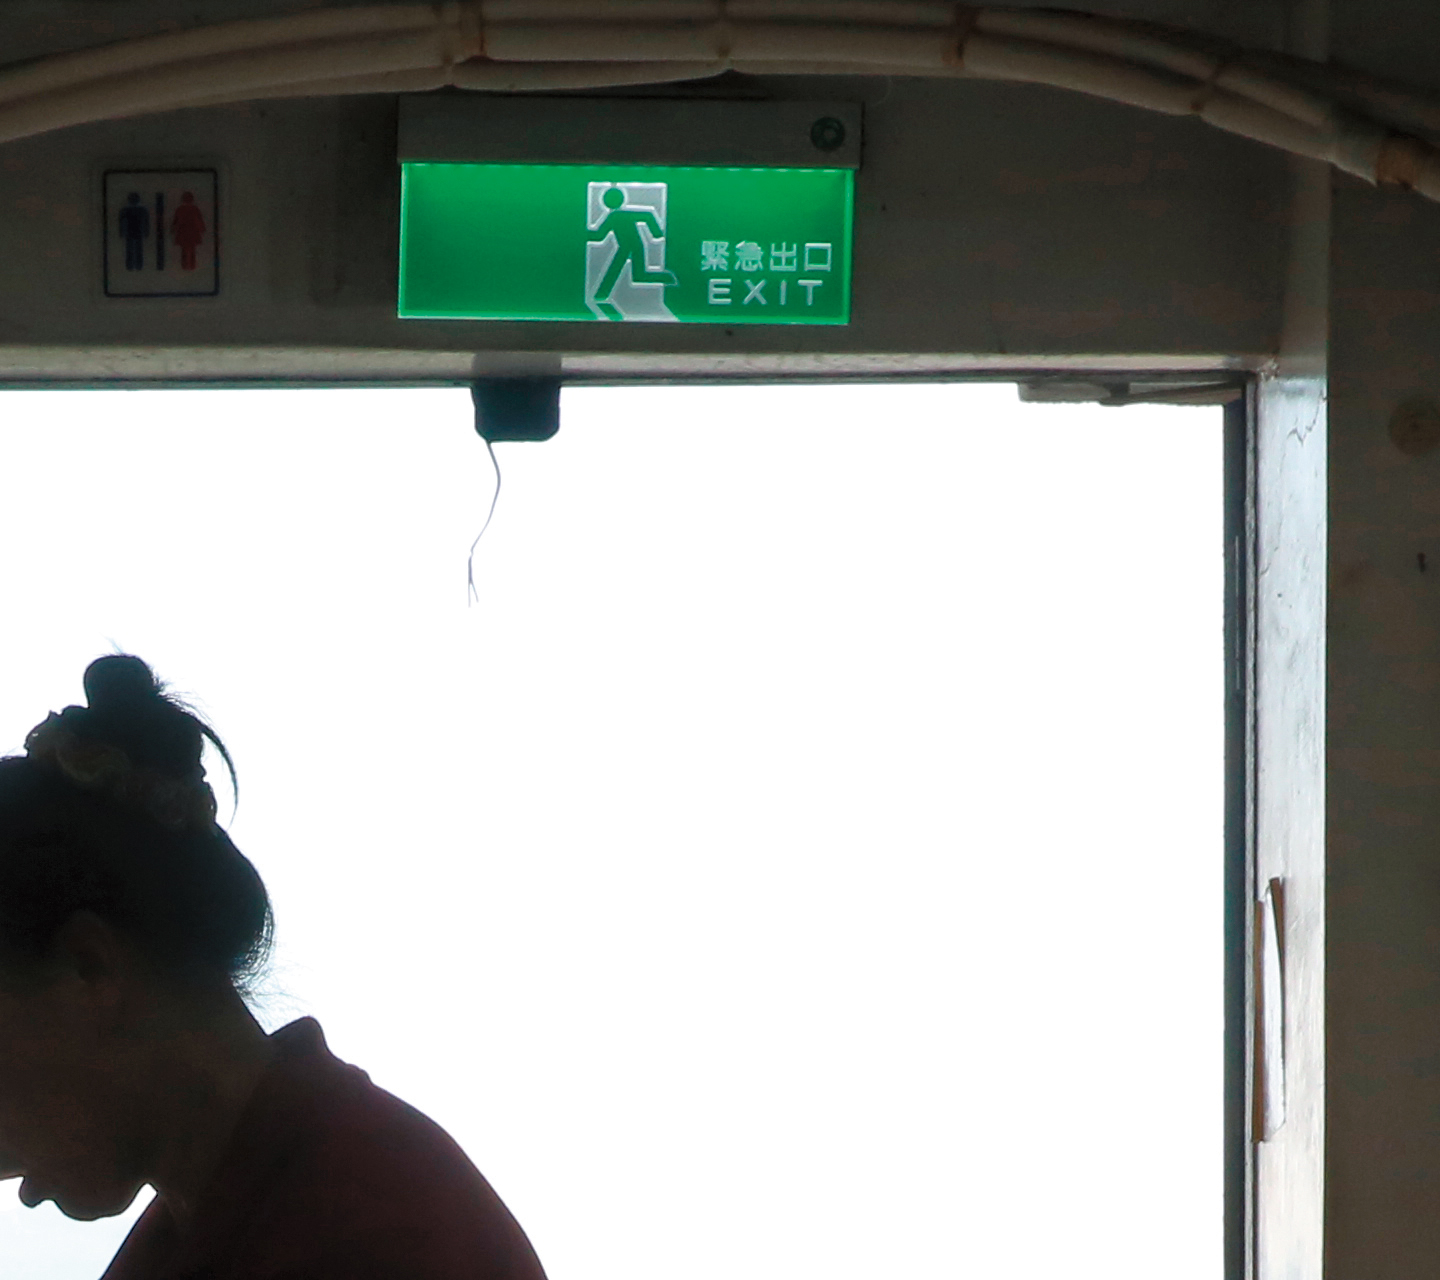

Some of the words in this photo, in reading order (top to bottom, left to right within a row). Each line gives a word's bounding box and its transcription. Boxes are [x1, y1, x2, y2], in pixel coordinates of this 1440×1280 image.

[701, 240, 832, 272] 緊急出口
[708, 278, 823, 306] EXIT
